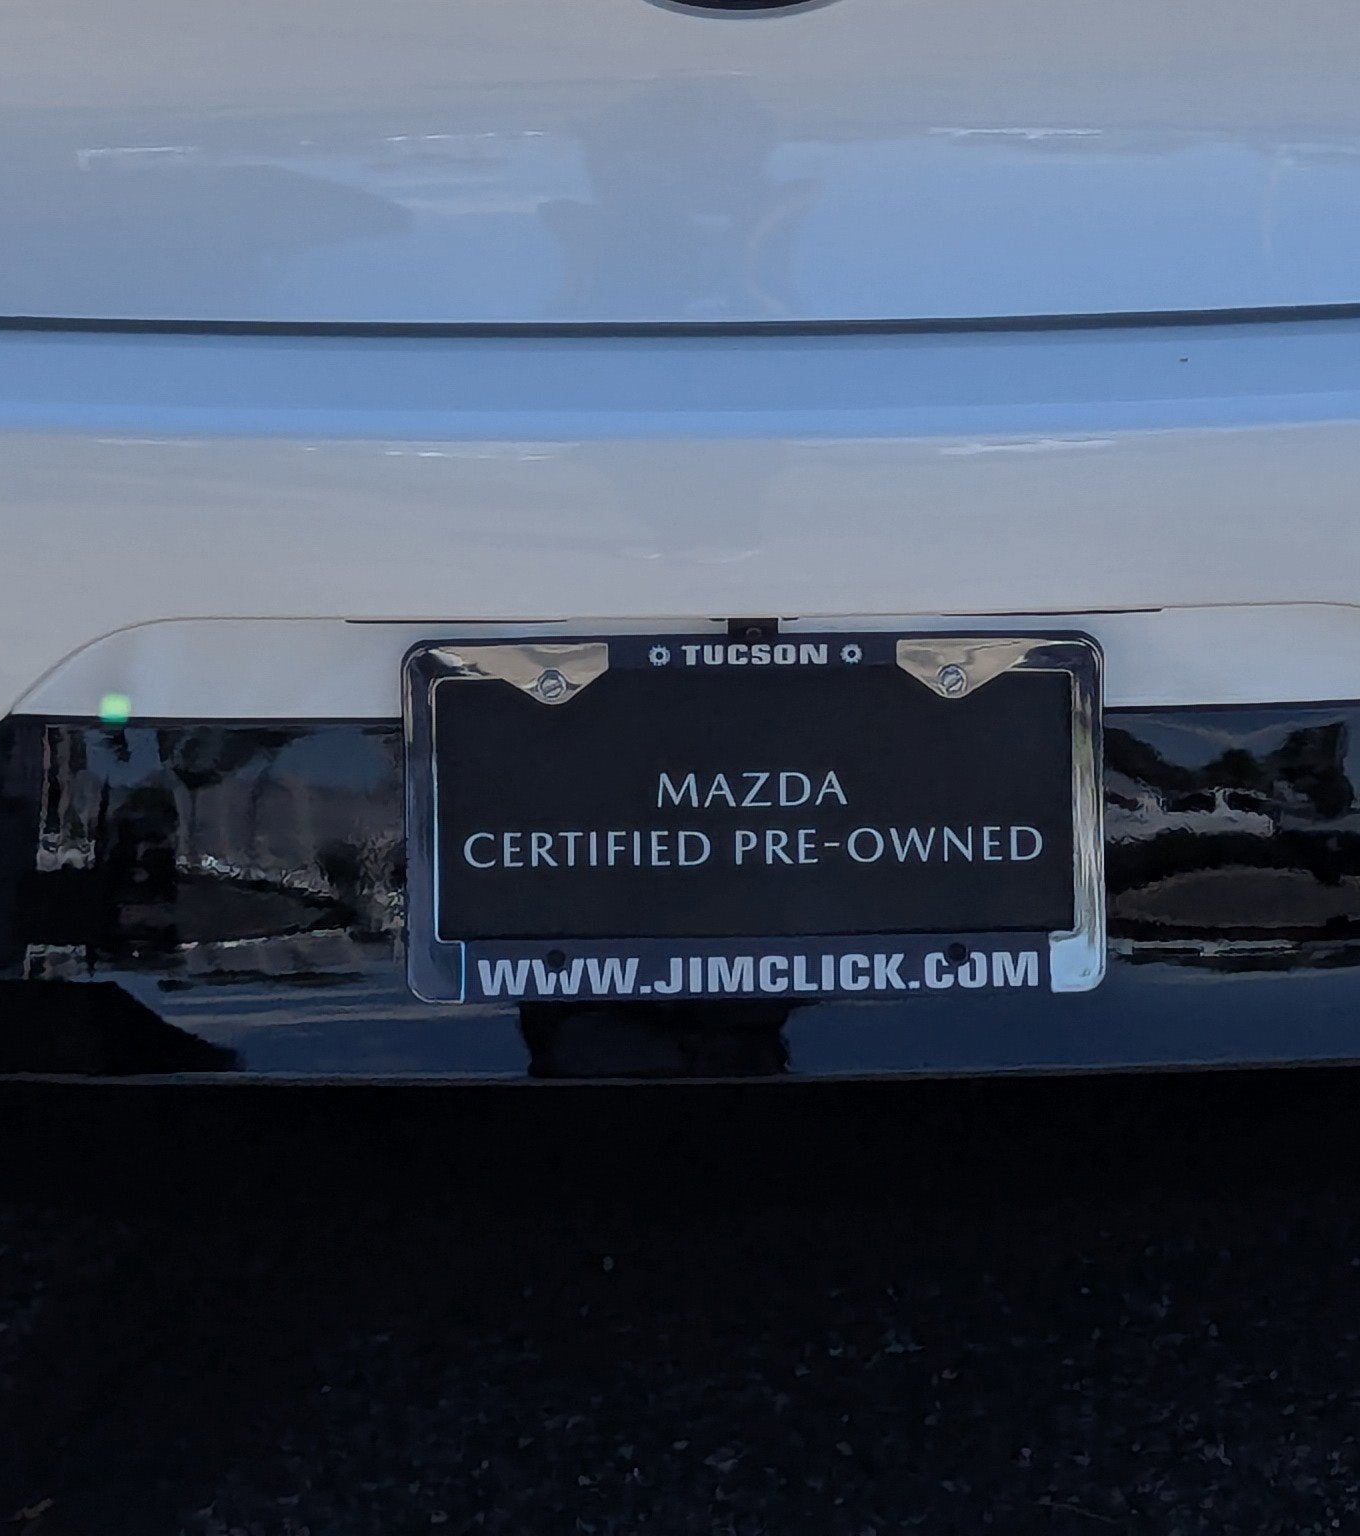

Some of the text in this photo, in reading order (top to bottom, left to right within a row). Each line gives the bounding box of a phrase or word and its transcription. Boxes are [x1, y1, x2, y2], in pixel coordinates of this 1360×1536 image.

[681, 643, 828, 666] TUCSON
[656, 771, 848, 808] MAZDA
[464, 825, 1043, 869] CERTIFIED PRE-OWNED
[477, 953, 1039, 997] WWW.JIMCLICK.COM
